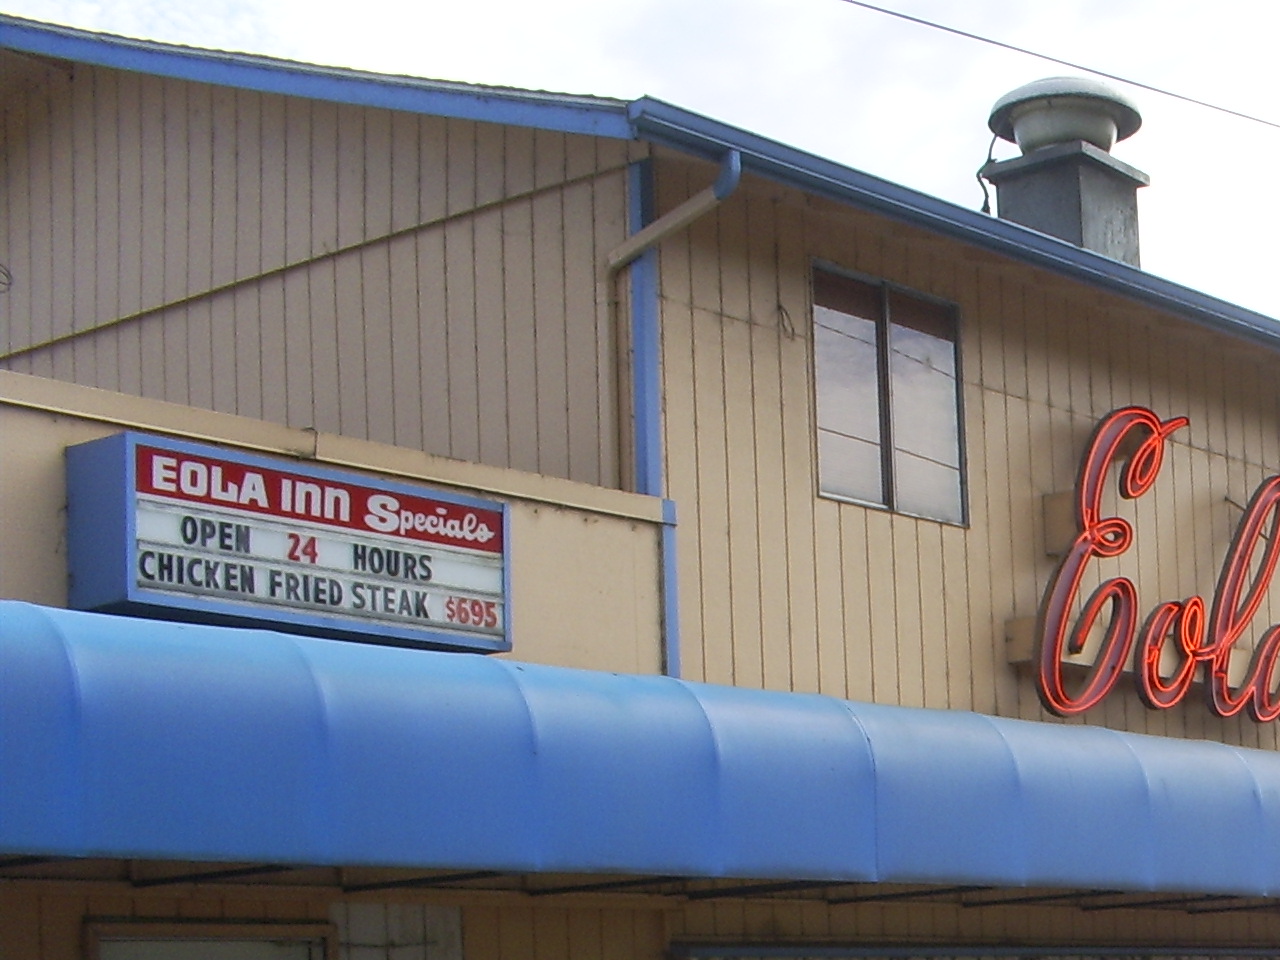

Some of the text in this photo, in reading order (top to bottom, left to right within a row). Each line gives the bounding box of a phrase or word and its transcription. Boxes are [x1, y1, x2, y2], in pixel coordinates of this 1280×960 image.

[152, 455, 269, 509] EOLA
[364, 494, 495, 544] Specials
[181, 515, 433, 581] OPEN 24 HOURS
[139, 551, 499, 628] CHICKEN FRIED STEAK $695
